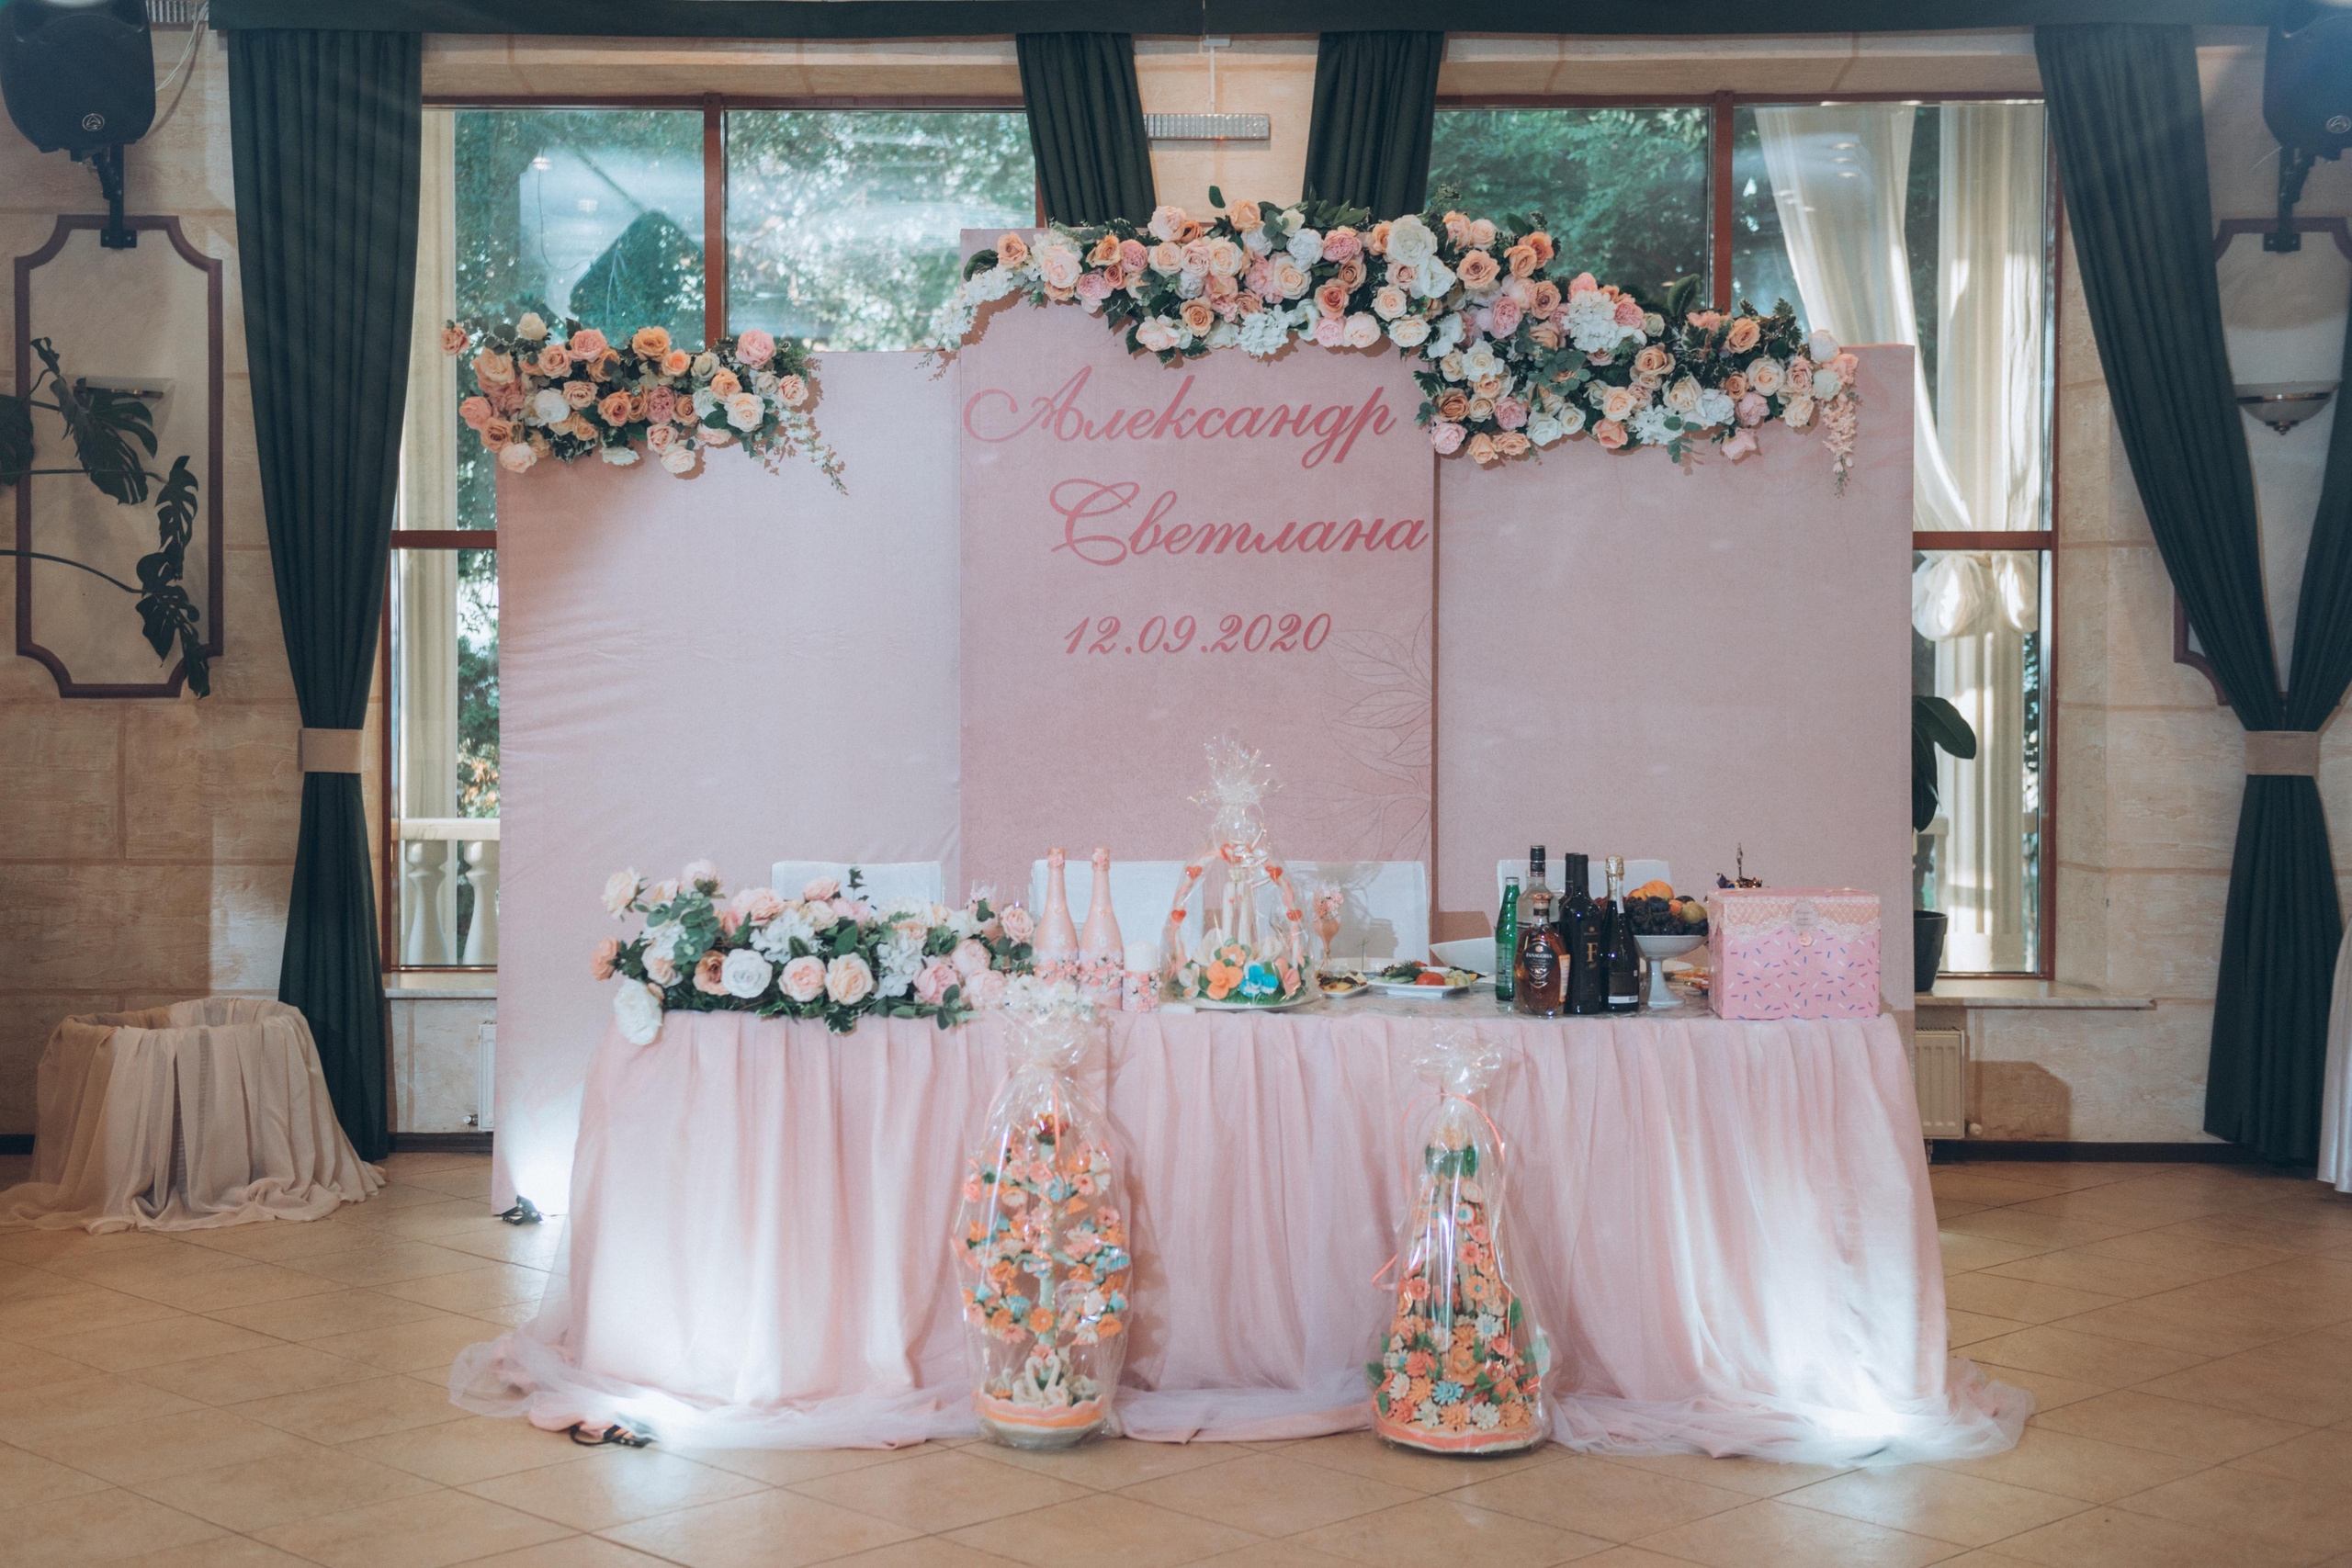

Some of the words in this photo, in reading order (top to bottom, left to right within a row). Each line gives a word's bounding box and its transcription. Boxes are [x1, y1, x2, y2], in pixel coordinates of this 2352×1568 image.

[964, 366, 1396, 468] Александр
[1050, 479, 1429, 566] Светлана
[1065, 613, 1332, 654] 12.09.2020
[1586, 942, 1599, 963] F
